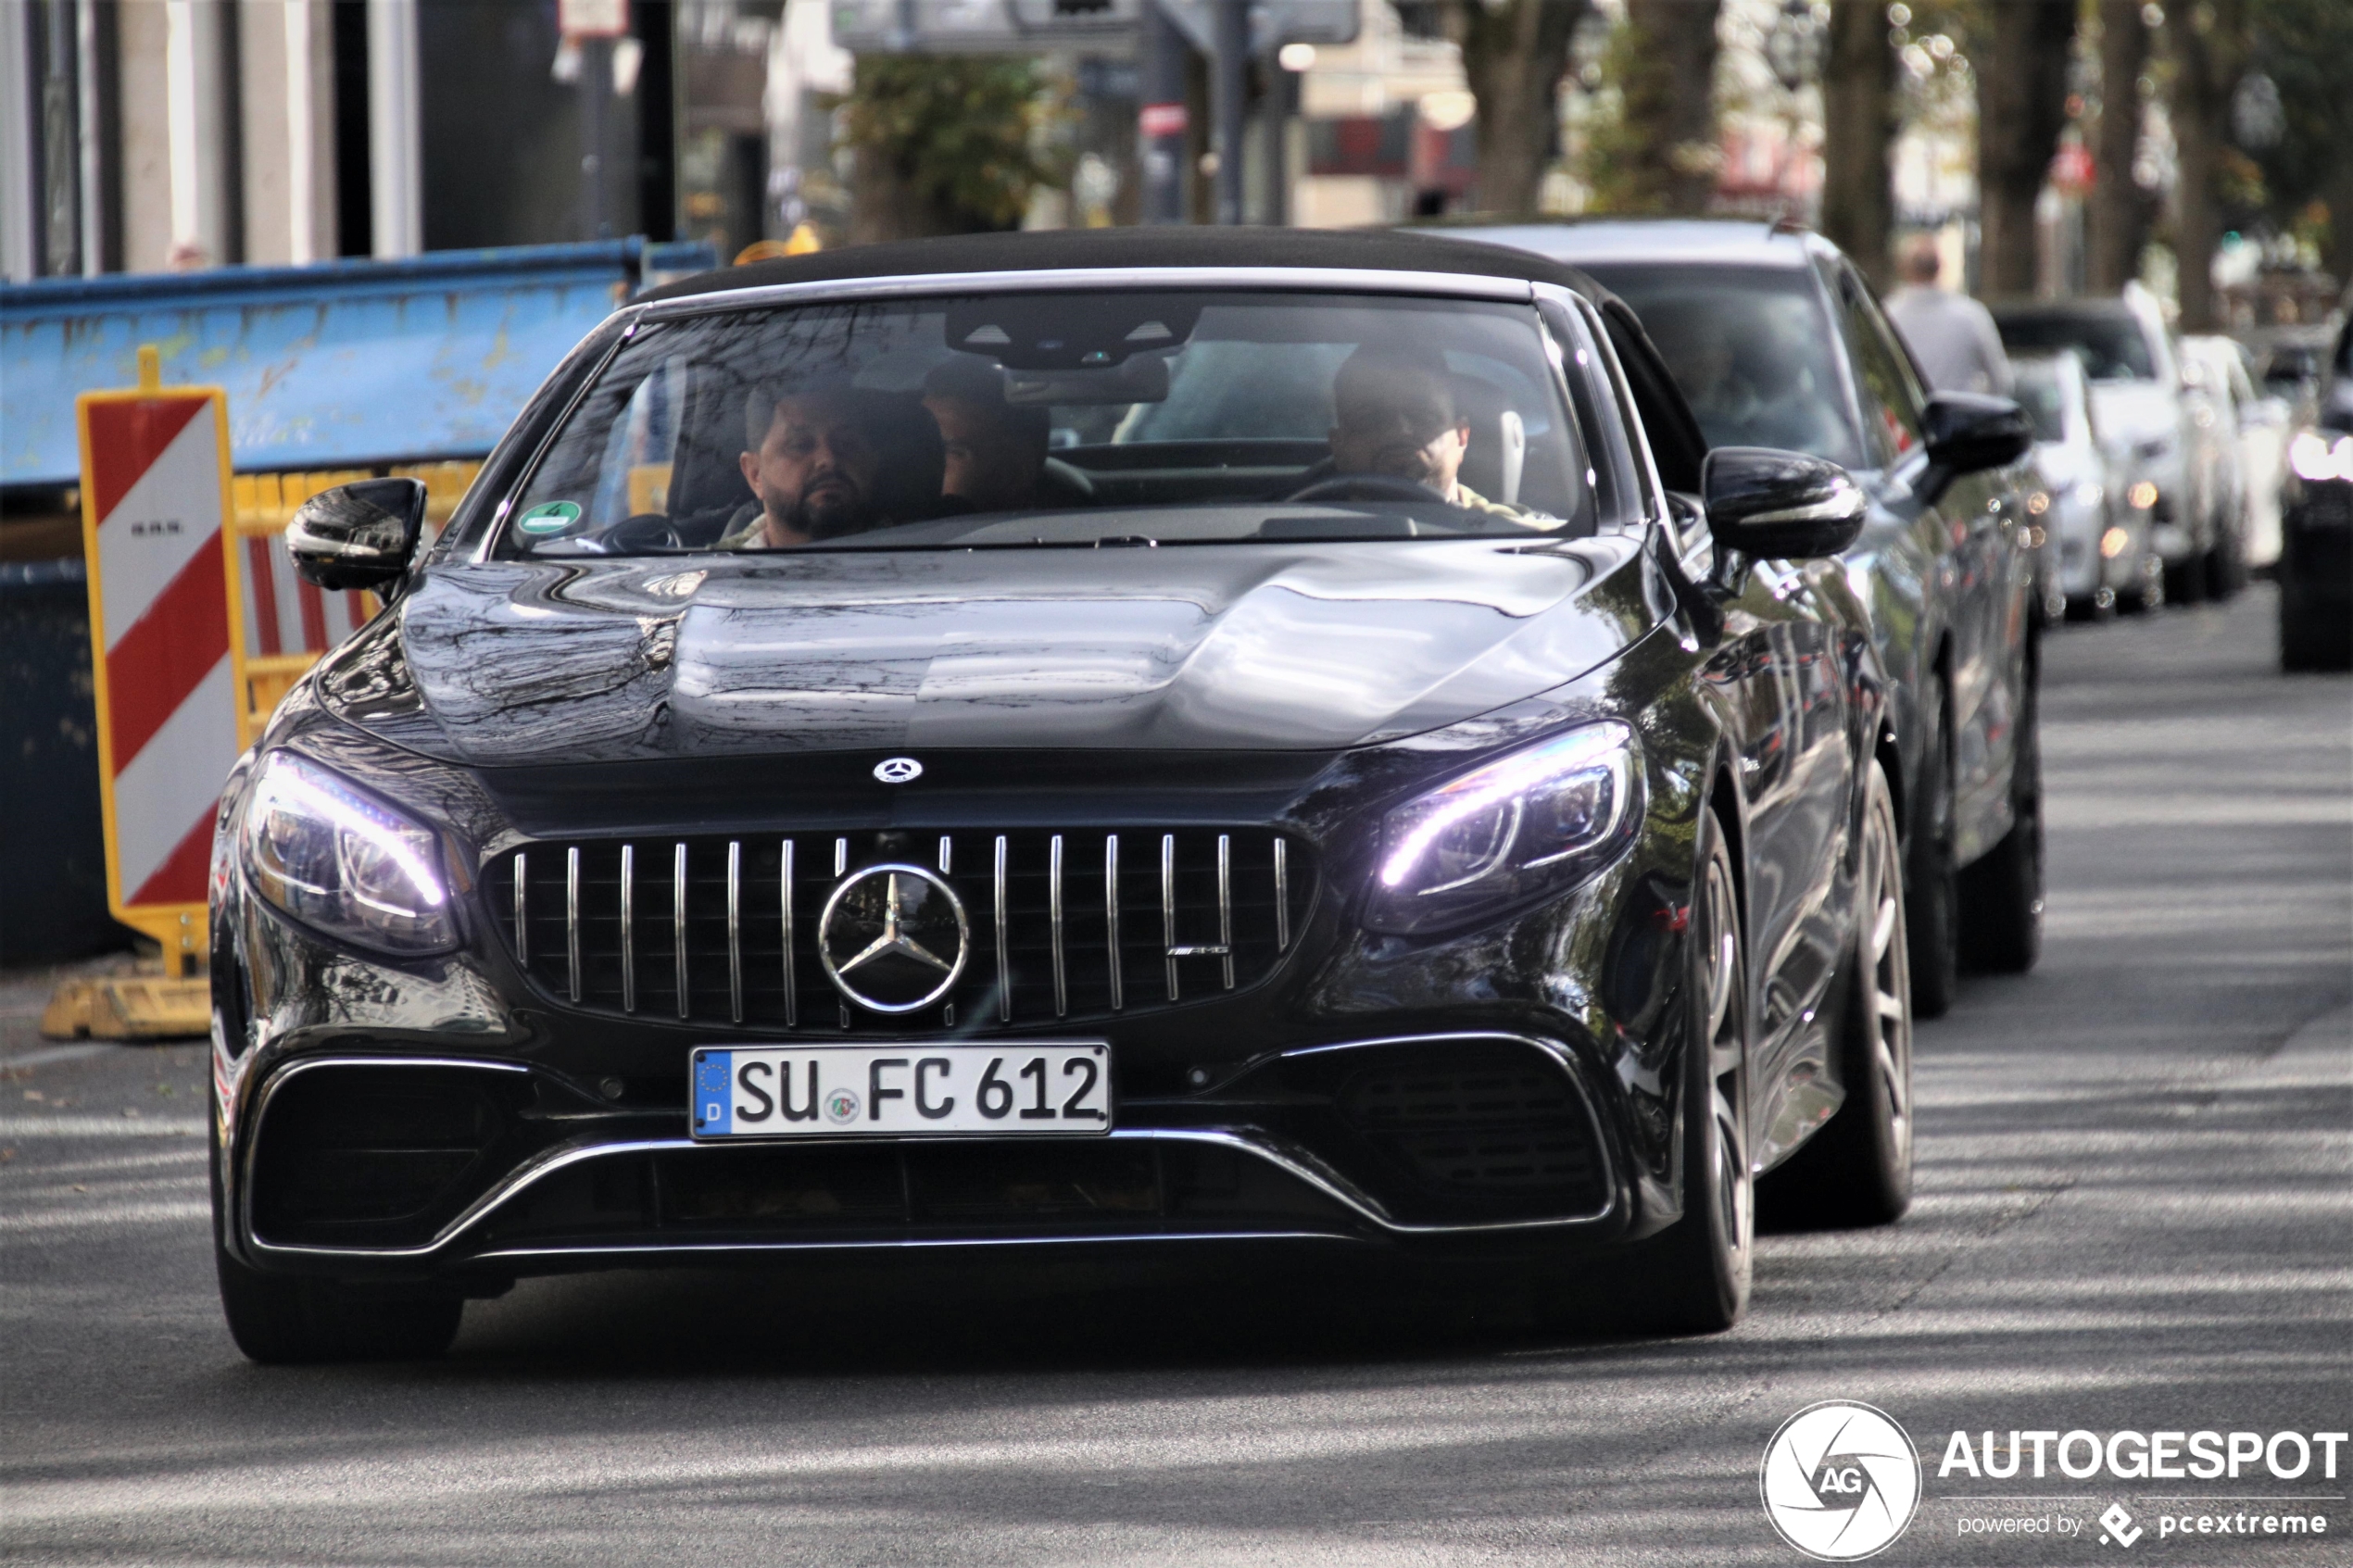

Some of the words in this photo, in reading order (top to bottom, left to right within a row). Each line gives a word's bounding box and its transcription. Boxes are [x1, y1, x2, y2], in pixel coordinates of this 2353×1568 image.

[545, 503, 562, 517] 4
[736, 1060, 818, 1123] SU
[869, 1058, 954, 1121] FC
[976, 1057, 1099, 1120] 612
[707, 1103, 721, 1121] D
